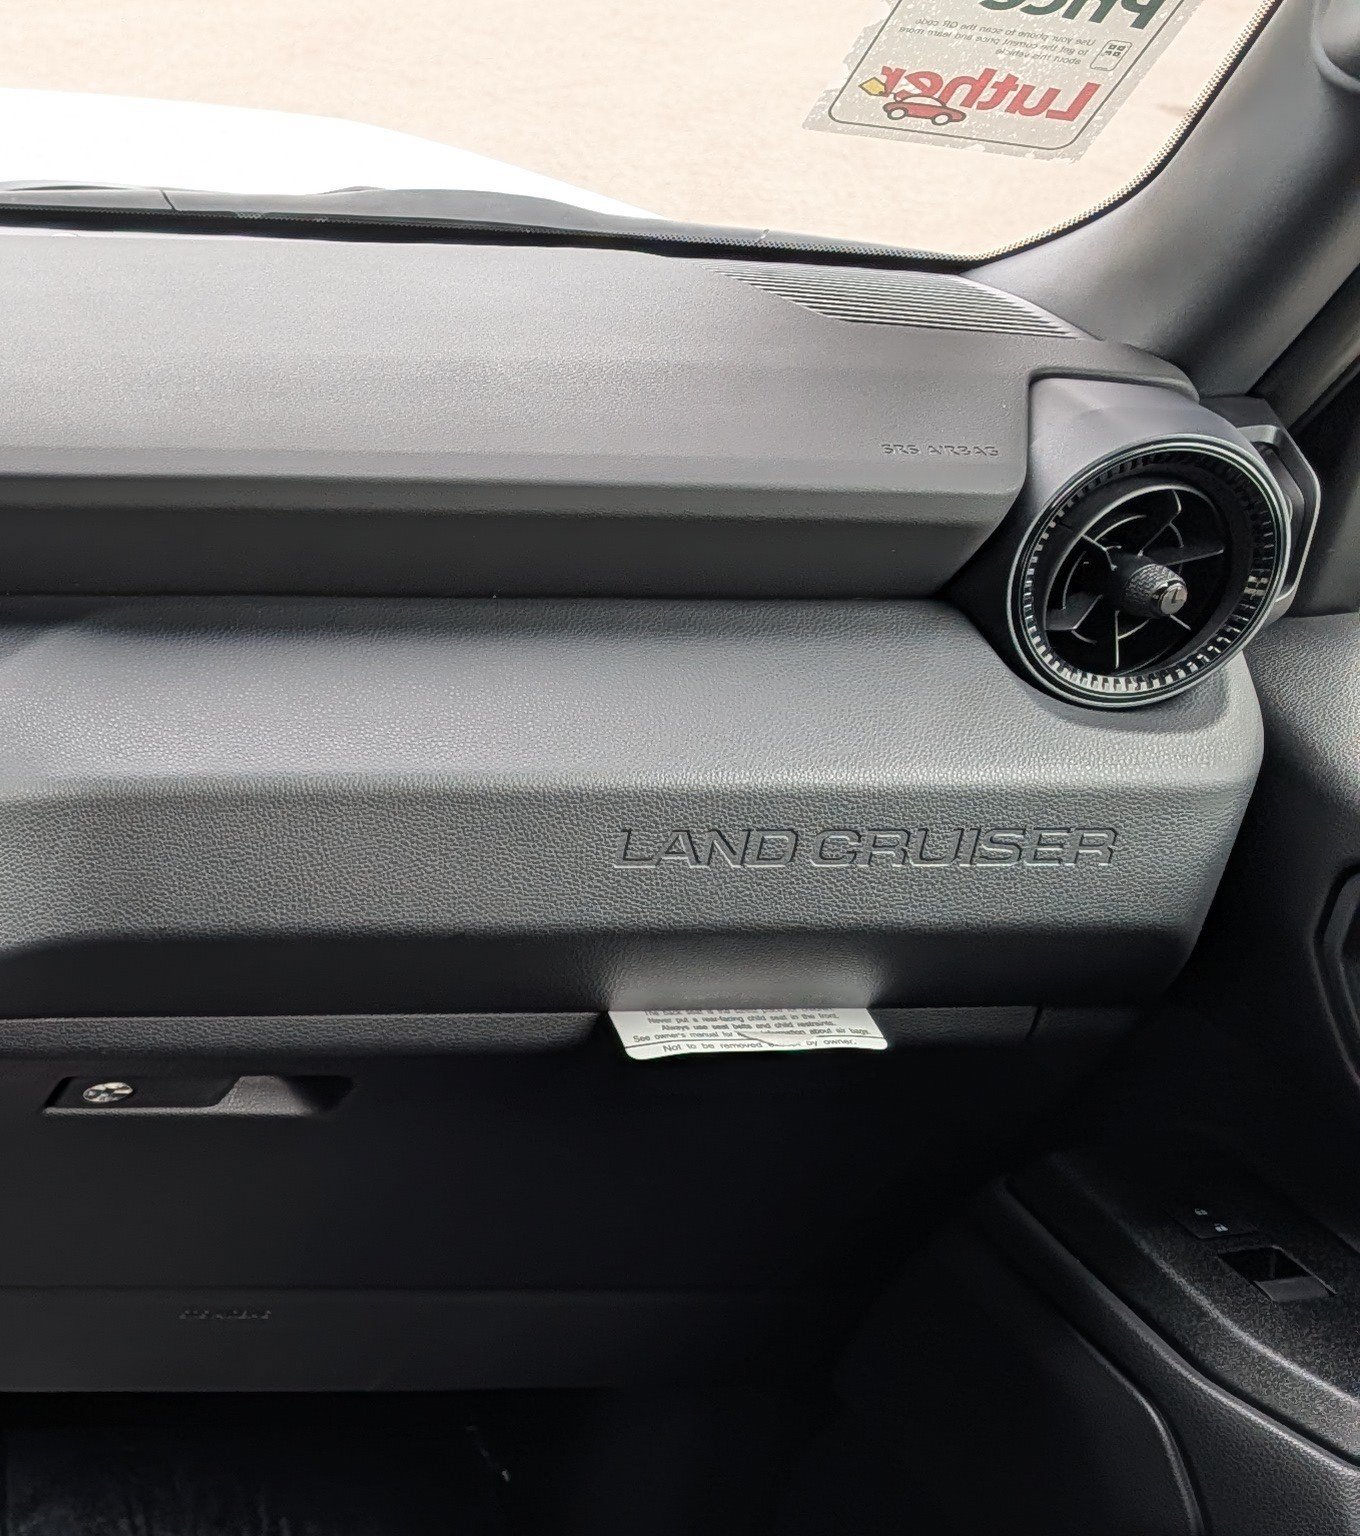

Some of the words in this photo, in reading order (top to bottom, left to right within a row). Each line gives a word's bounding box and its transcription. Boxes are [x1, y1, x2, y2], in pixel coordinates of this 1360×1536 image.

[613, 826, 799, 869] LAND
[809, 826, 1119, 868] CRUISER
[654, 1032, 685, 1040] owner's
[662, 1044, 682, 1052] Not
[720, 1041, 763, 1049] removed
